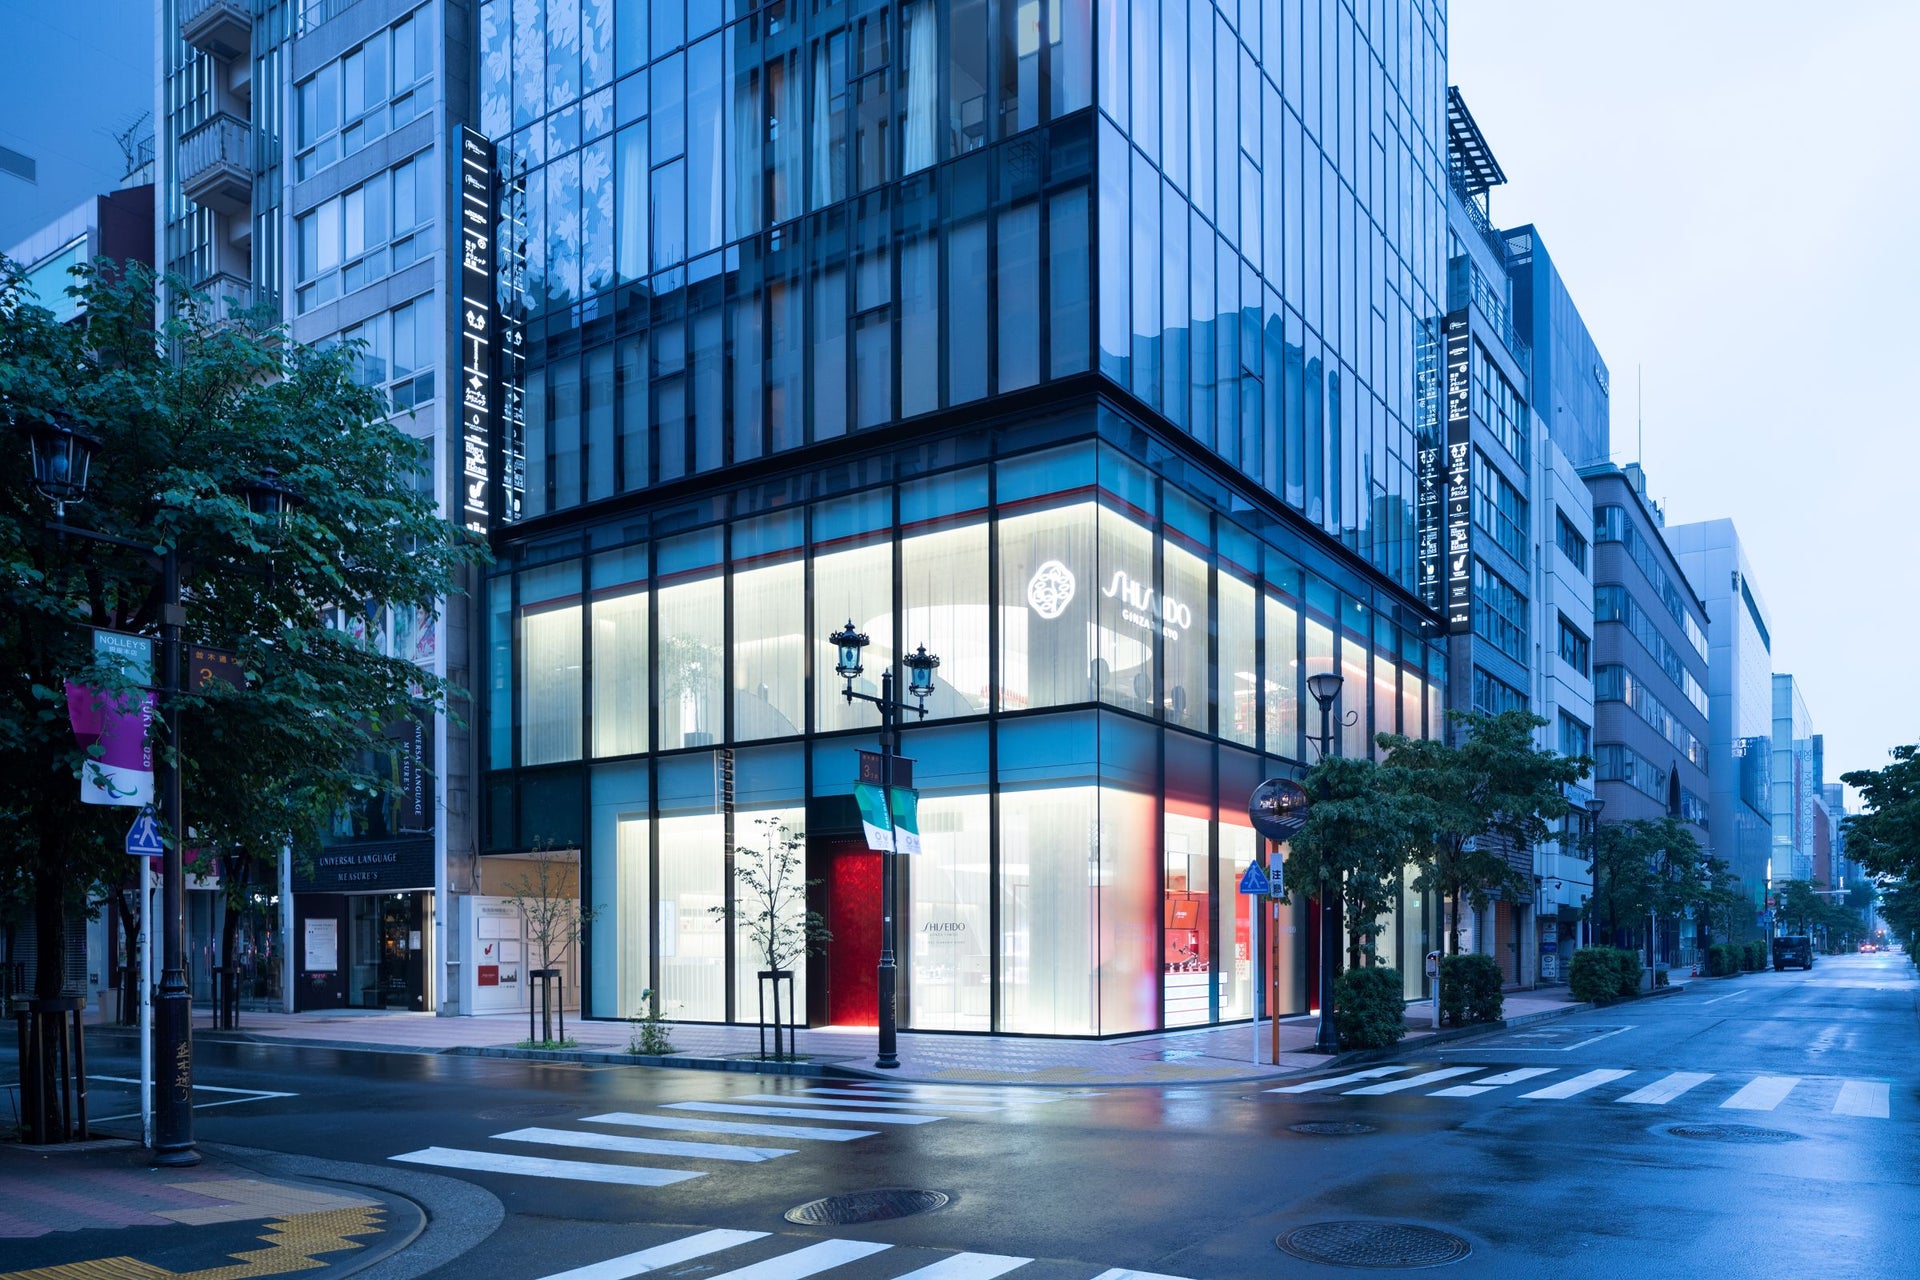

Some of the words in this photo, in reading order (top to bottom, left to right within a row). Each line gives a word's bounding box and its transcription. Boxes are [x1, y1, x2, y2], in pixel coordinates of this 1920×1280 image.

[1102, 570, 1191, 630] SHISIDO
[1122, 609, 1150, 629] GINZA
[99, 635, 147, 650] NOLLEY'S
[414, 768, 422, 816] LANGUAGE
[319, 854, 356, 866] UNIVERSAL
[357, 852, 398, 864] LANGUAGE
[337, 871, 378, 881] MEASURE'S
[921, 922, 966, 932] SHISEIDO
